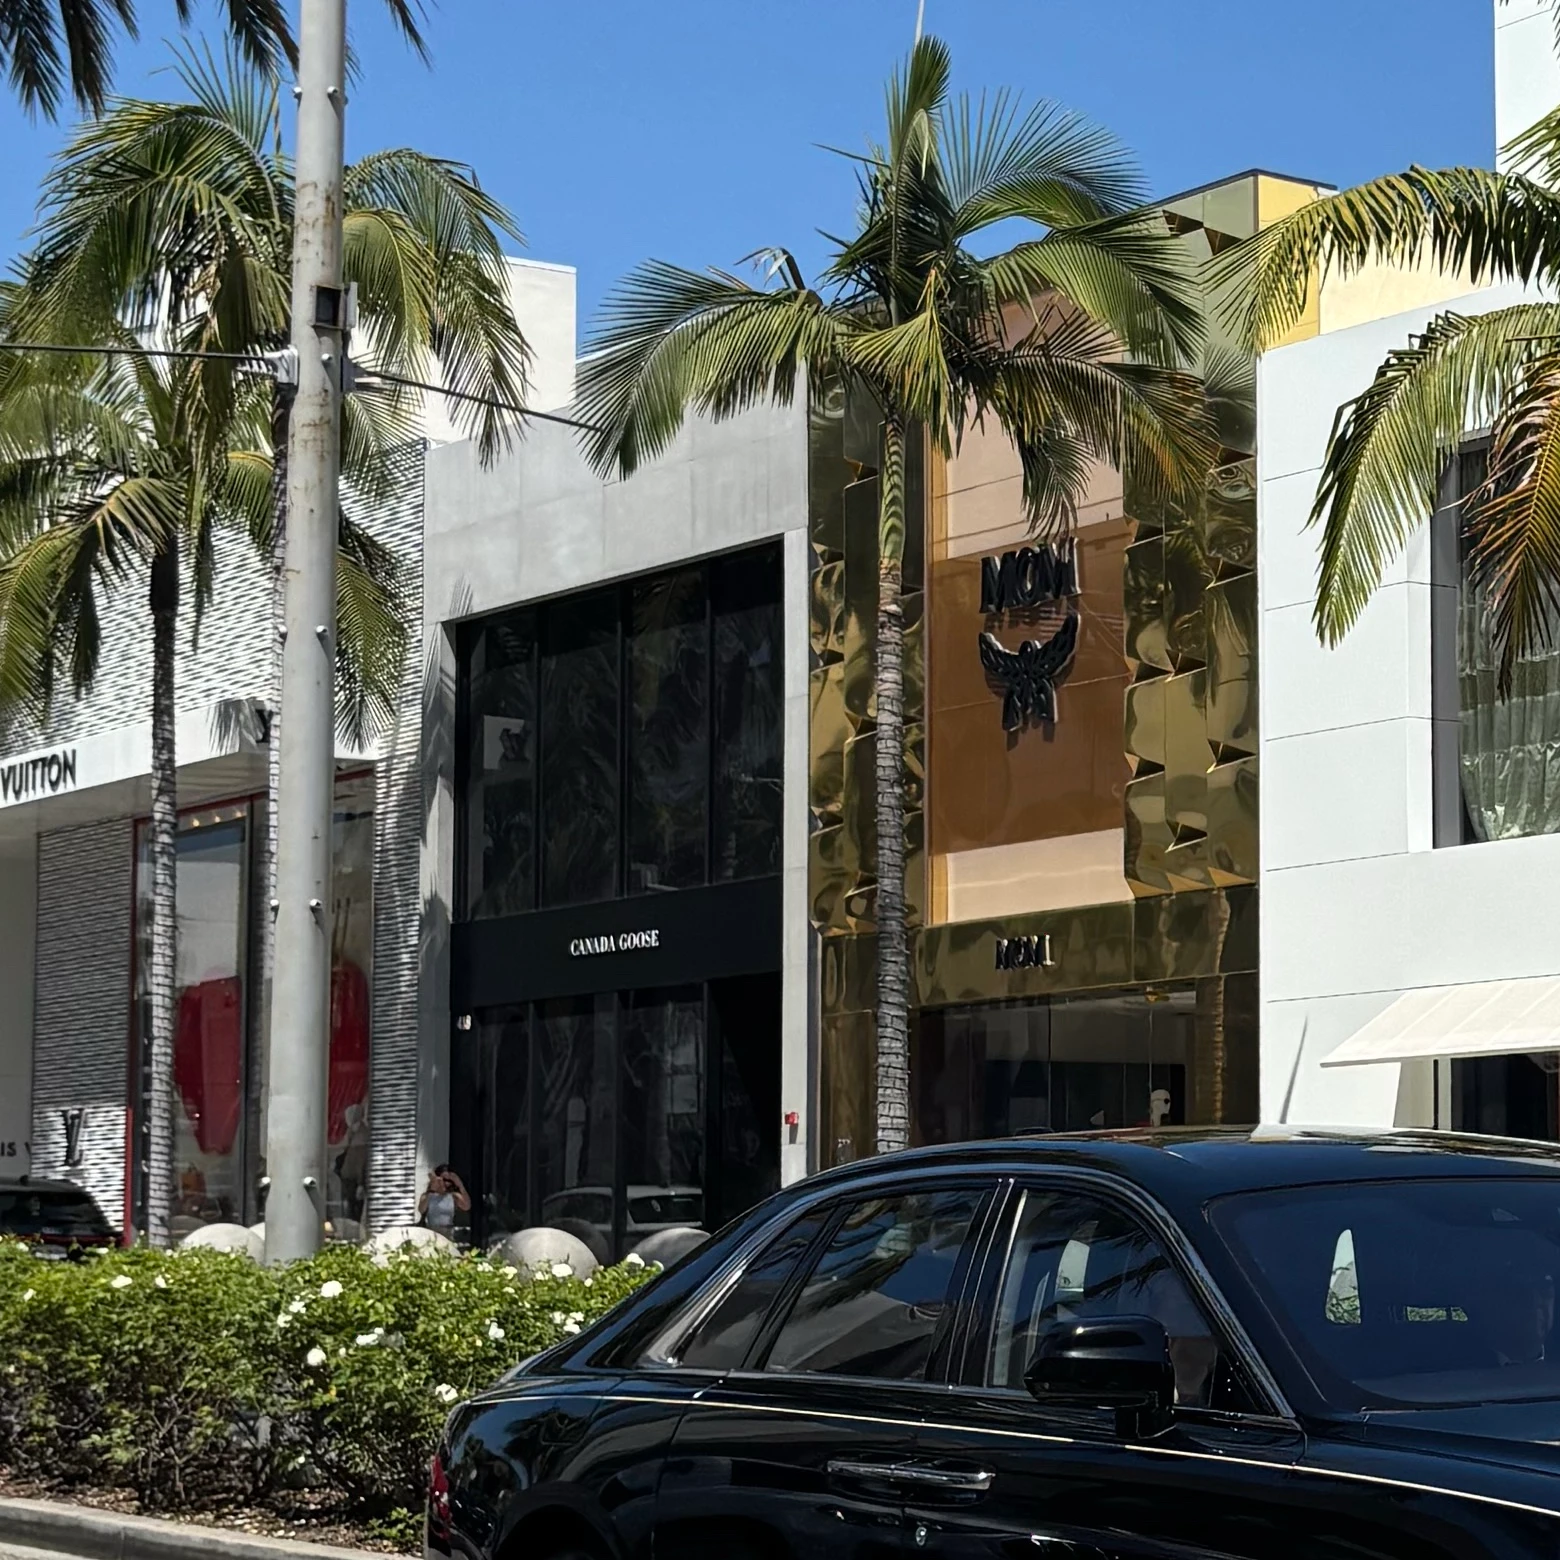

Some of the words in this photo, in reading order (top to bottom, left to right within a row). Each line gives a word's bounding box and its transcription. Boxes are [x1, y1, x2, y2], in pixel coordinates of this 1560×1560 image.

[979, 536, 1081, 614] MCM
[0, 748, 77, 801] VUITTON
[570, 935, 616, 957] CANADA
[619, 929, 660, 951] GOOSE
[995, 934, 1055, 970] MCM
